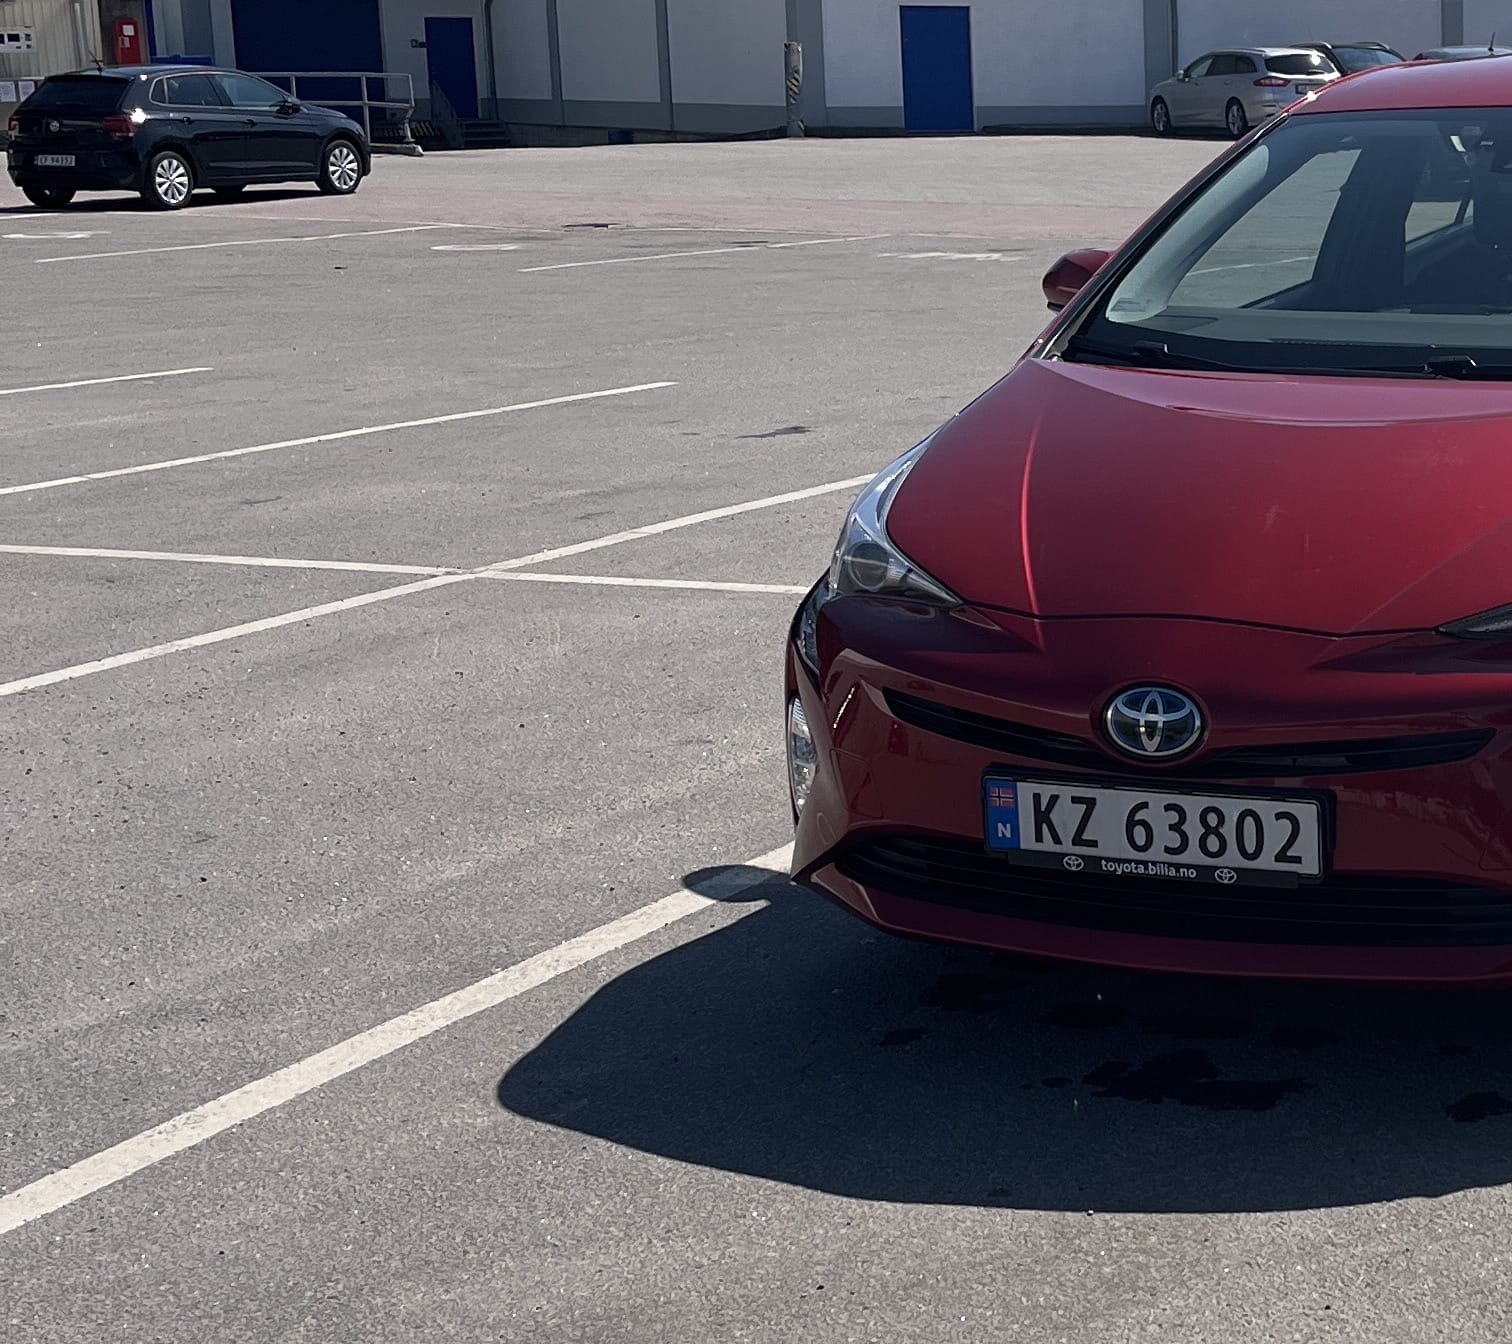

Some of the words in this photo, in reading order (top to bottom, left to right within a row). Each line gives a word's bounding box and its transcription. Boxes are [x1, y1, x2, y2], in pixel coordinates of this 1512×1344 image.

[997, 822, 1012, 839] N
[1032, 792, 1098, 849] KZ
[1125, 801, 1303, 865] 63802
[1101, 859, 1197, 878] toyota.bilia.no
